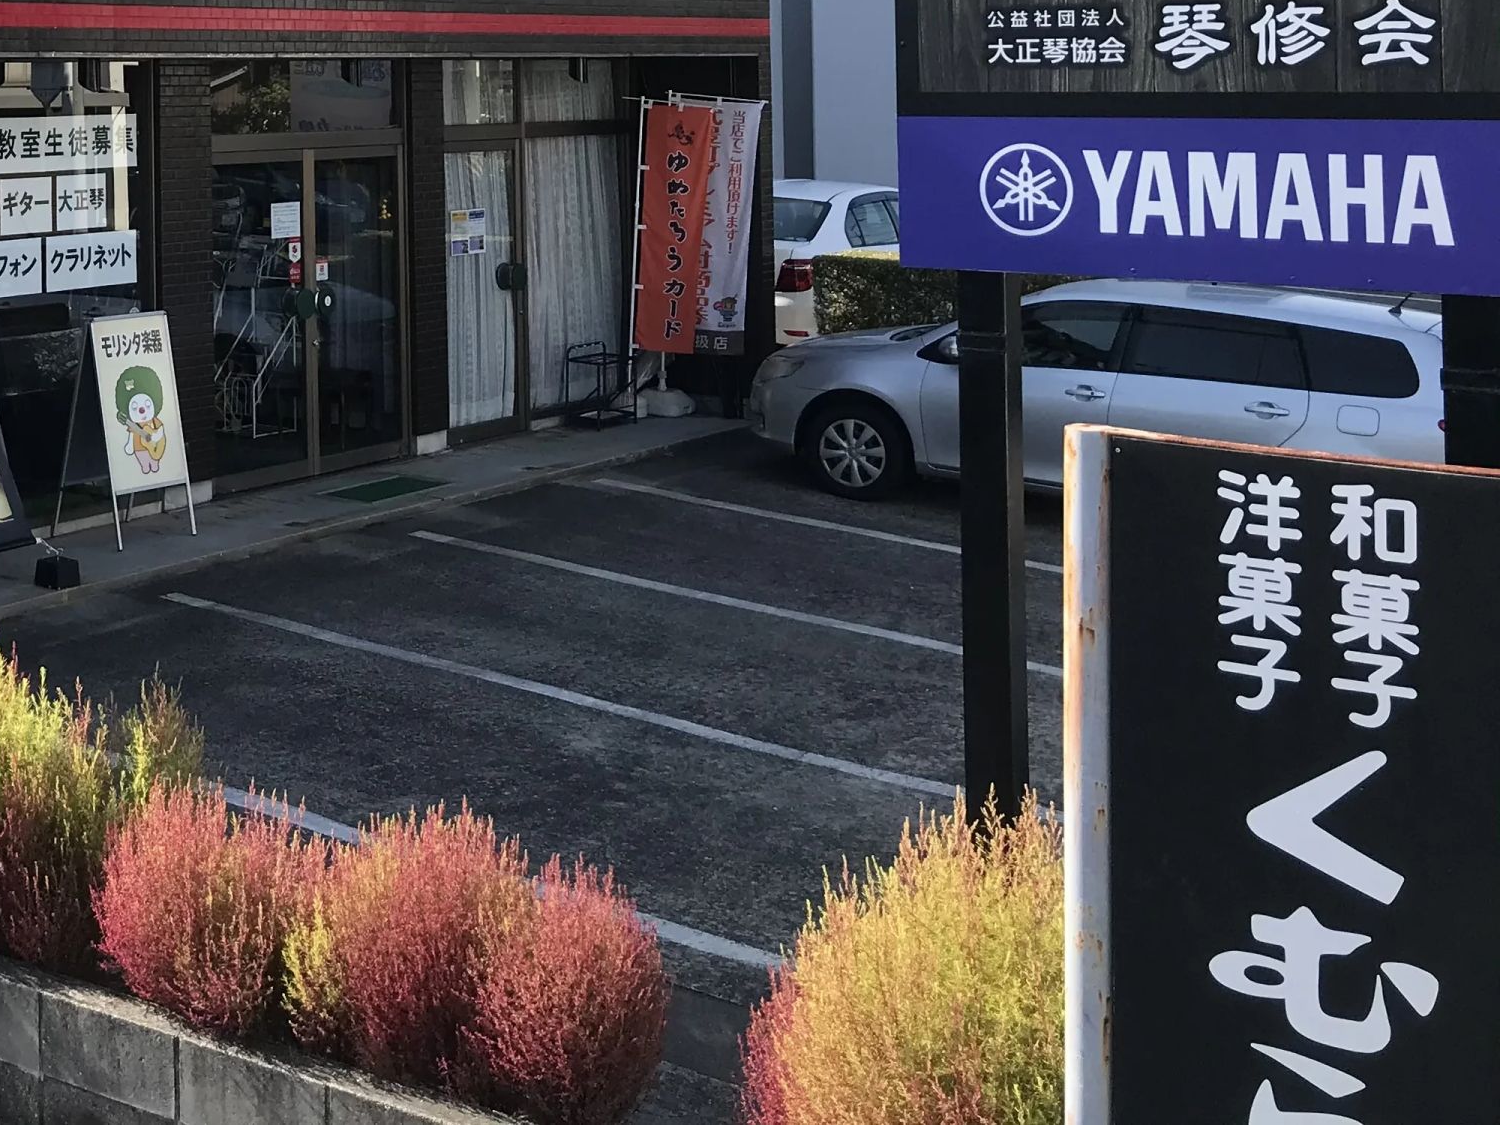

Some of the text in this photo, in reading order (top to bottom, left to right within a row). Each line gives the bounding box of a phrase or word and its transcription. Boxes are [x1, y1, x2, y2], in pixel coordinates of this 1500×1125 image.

[987, 8, 1126, 29] 公益社団法人
[987, 37, 1127, 65] 大正琴協会
[2, 191, 50, 217] ギター
[58, 187, 105, 213] 大正琴
[1082, 149, 1456, 248] YAMAHA
[50, 243, 133, 274] クラリネット
[664, 150, 691, 340] ゆめたろうカード
[101, 329, 163, 358] モリシタ楽器
[1217, 468, 1303, 712] 洋菓子
[1329, 483, 1421, 729] 和菓子
